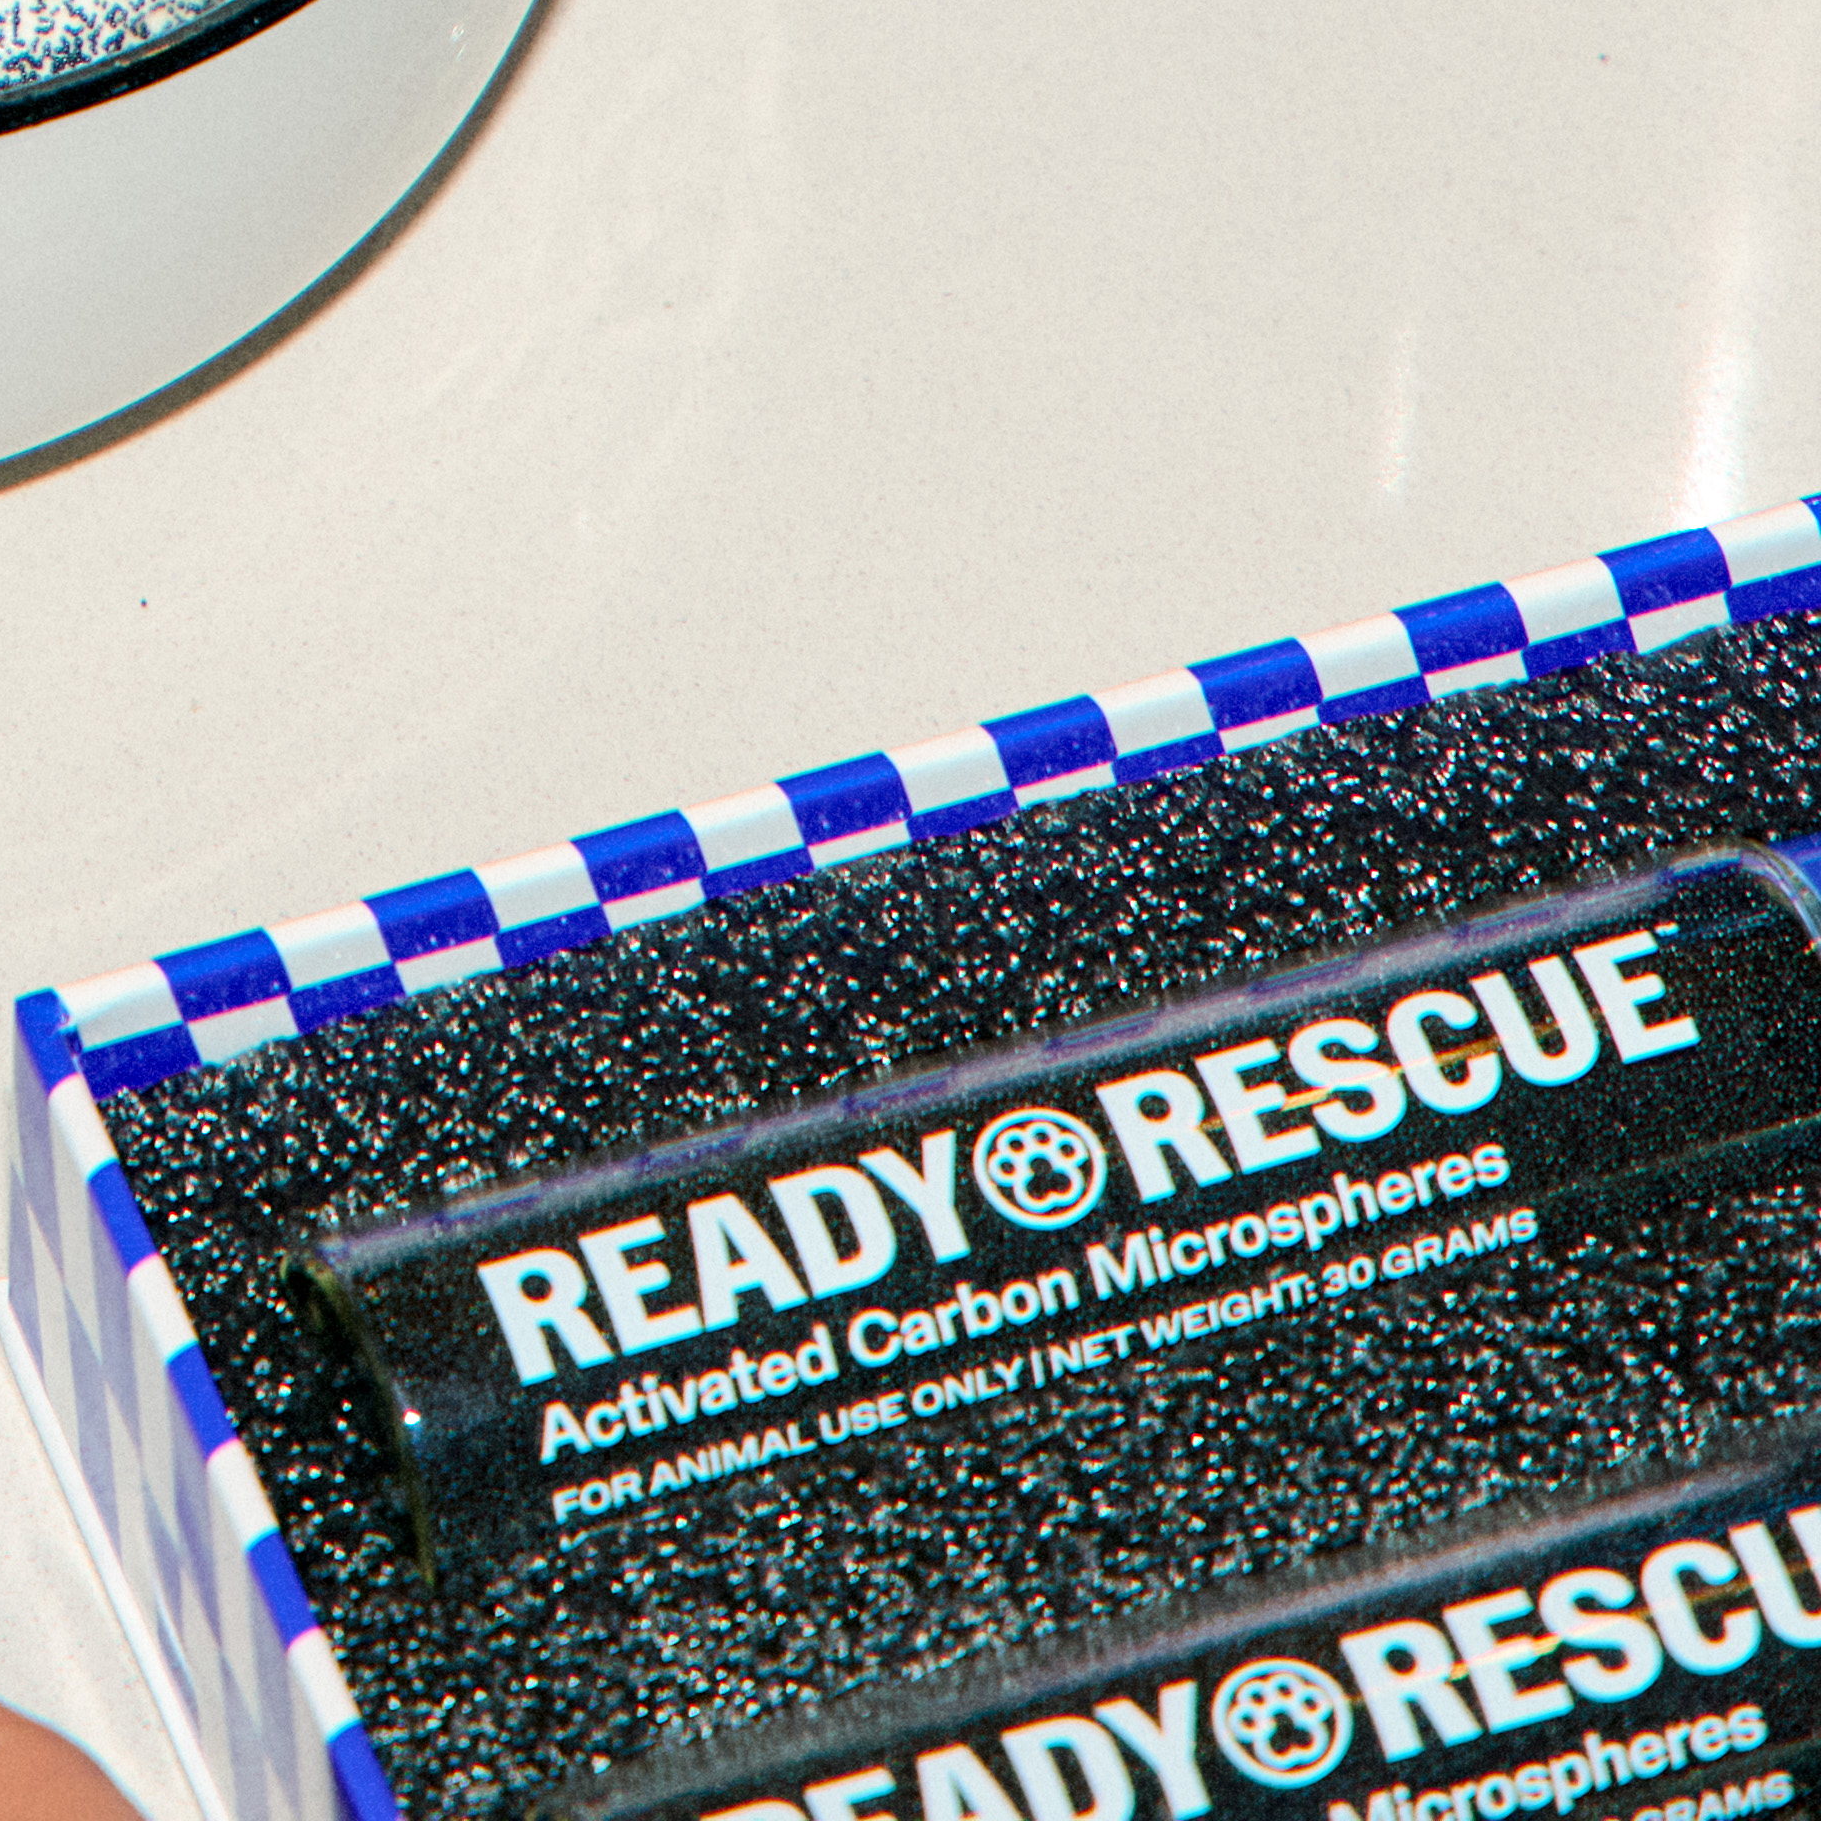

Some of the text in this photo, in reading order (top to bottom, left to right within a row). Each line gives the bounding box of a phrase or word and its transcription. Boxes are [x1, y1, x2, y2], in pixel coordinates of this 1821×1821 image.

[478, 1130, 971, 1386] READY
[540, 1143, 1511, 1465] Activated Carbon Microspheres
[552, 1469, 644, 1525] FOR
[648, 1422, 817, 1495] ANIMAL
[818, 1390, 910, 1446] USE
[910, 1355, 1026, 1418] ONLY
[1049, 1324, 1137, 1379] NET
[1140, 1274, 1319, 1350] WEIGHT:
[1323, 1255, 1376, 1300] 30
[1379, 1206, 1539, 1281] GRAMS
